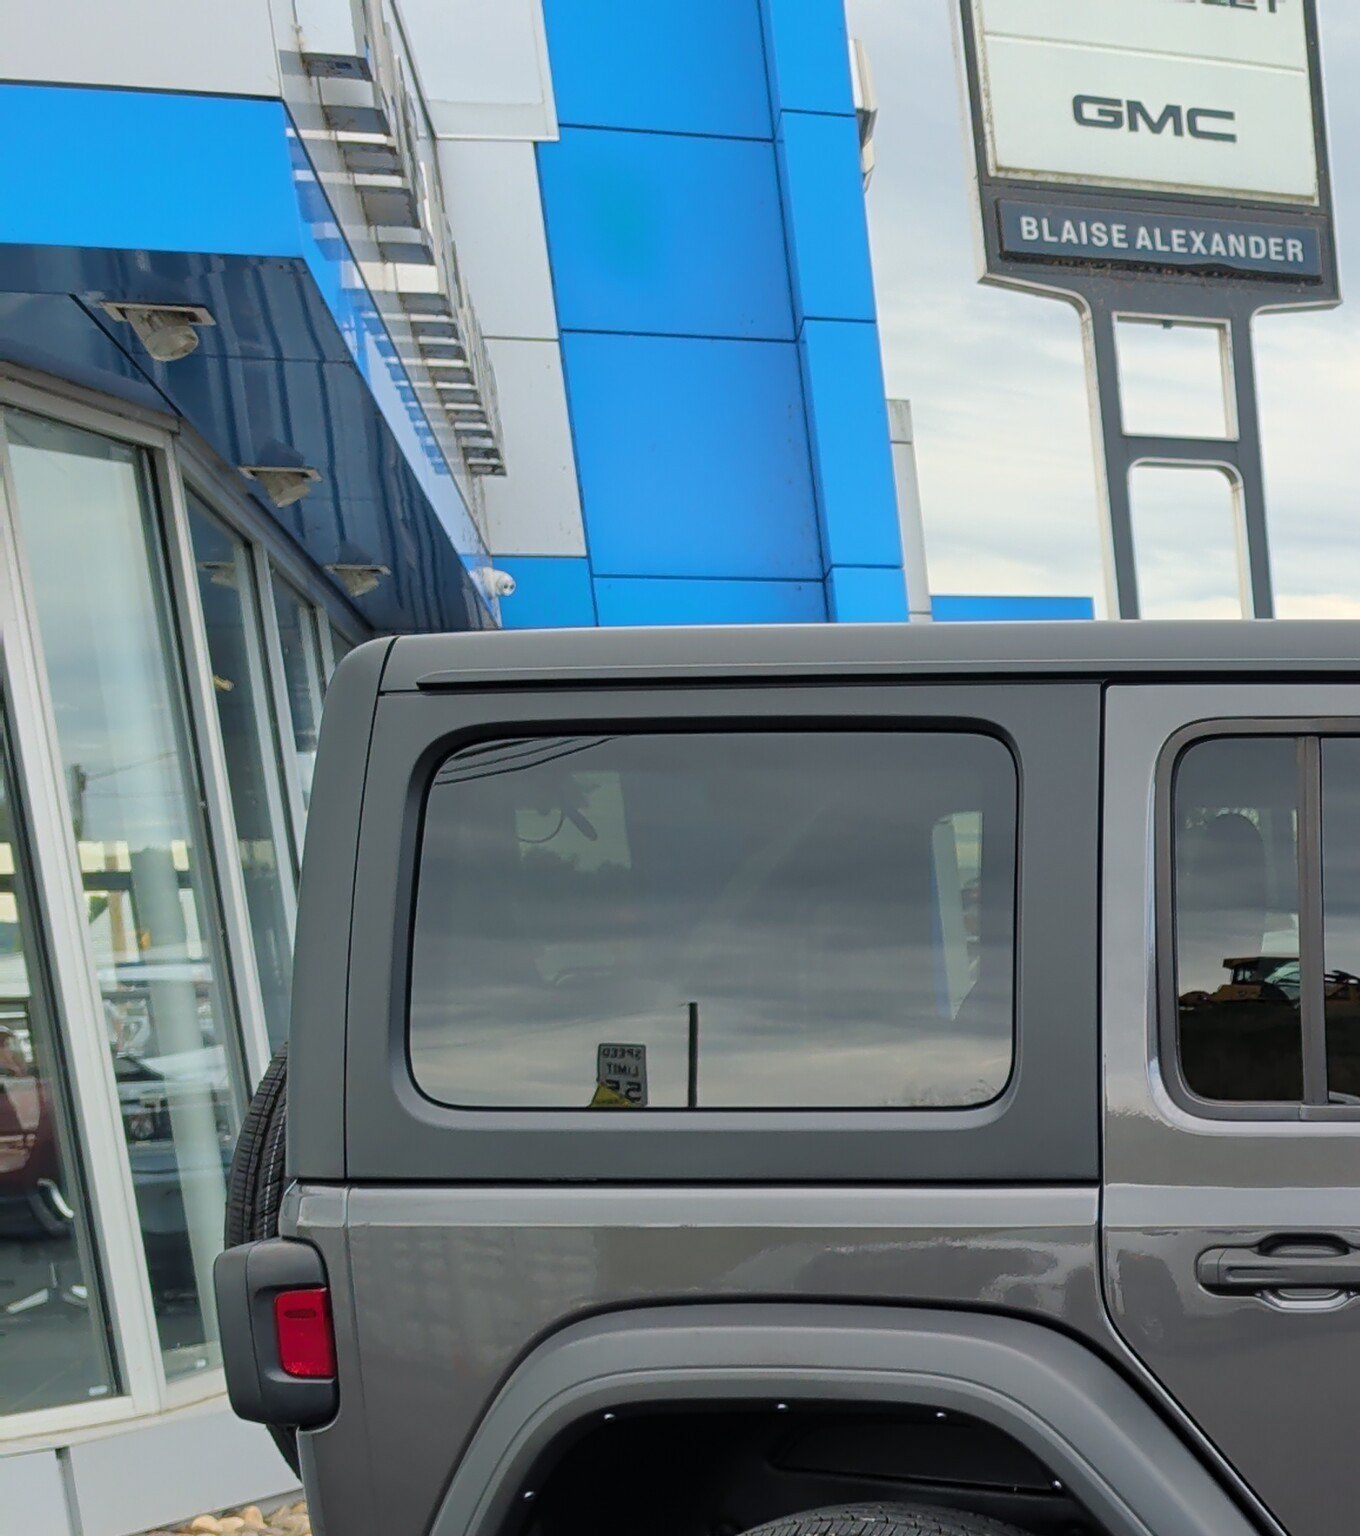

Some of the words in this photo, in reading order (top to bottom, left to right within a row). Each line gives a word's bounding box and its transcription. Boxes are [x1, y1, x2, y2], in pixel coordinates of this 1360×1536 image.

[1072, 94, 1237, 143] GMC
[1019, 216, 1129, 250] BLAISE
[1136, 226, 1305, 263] ALEXANDER
